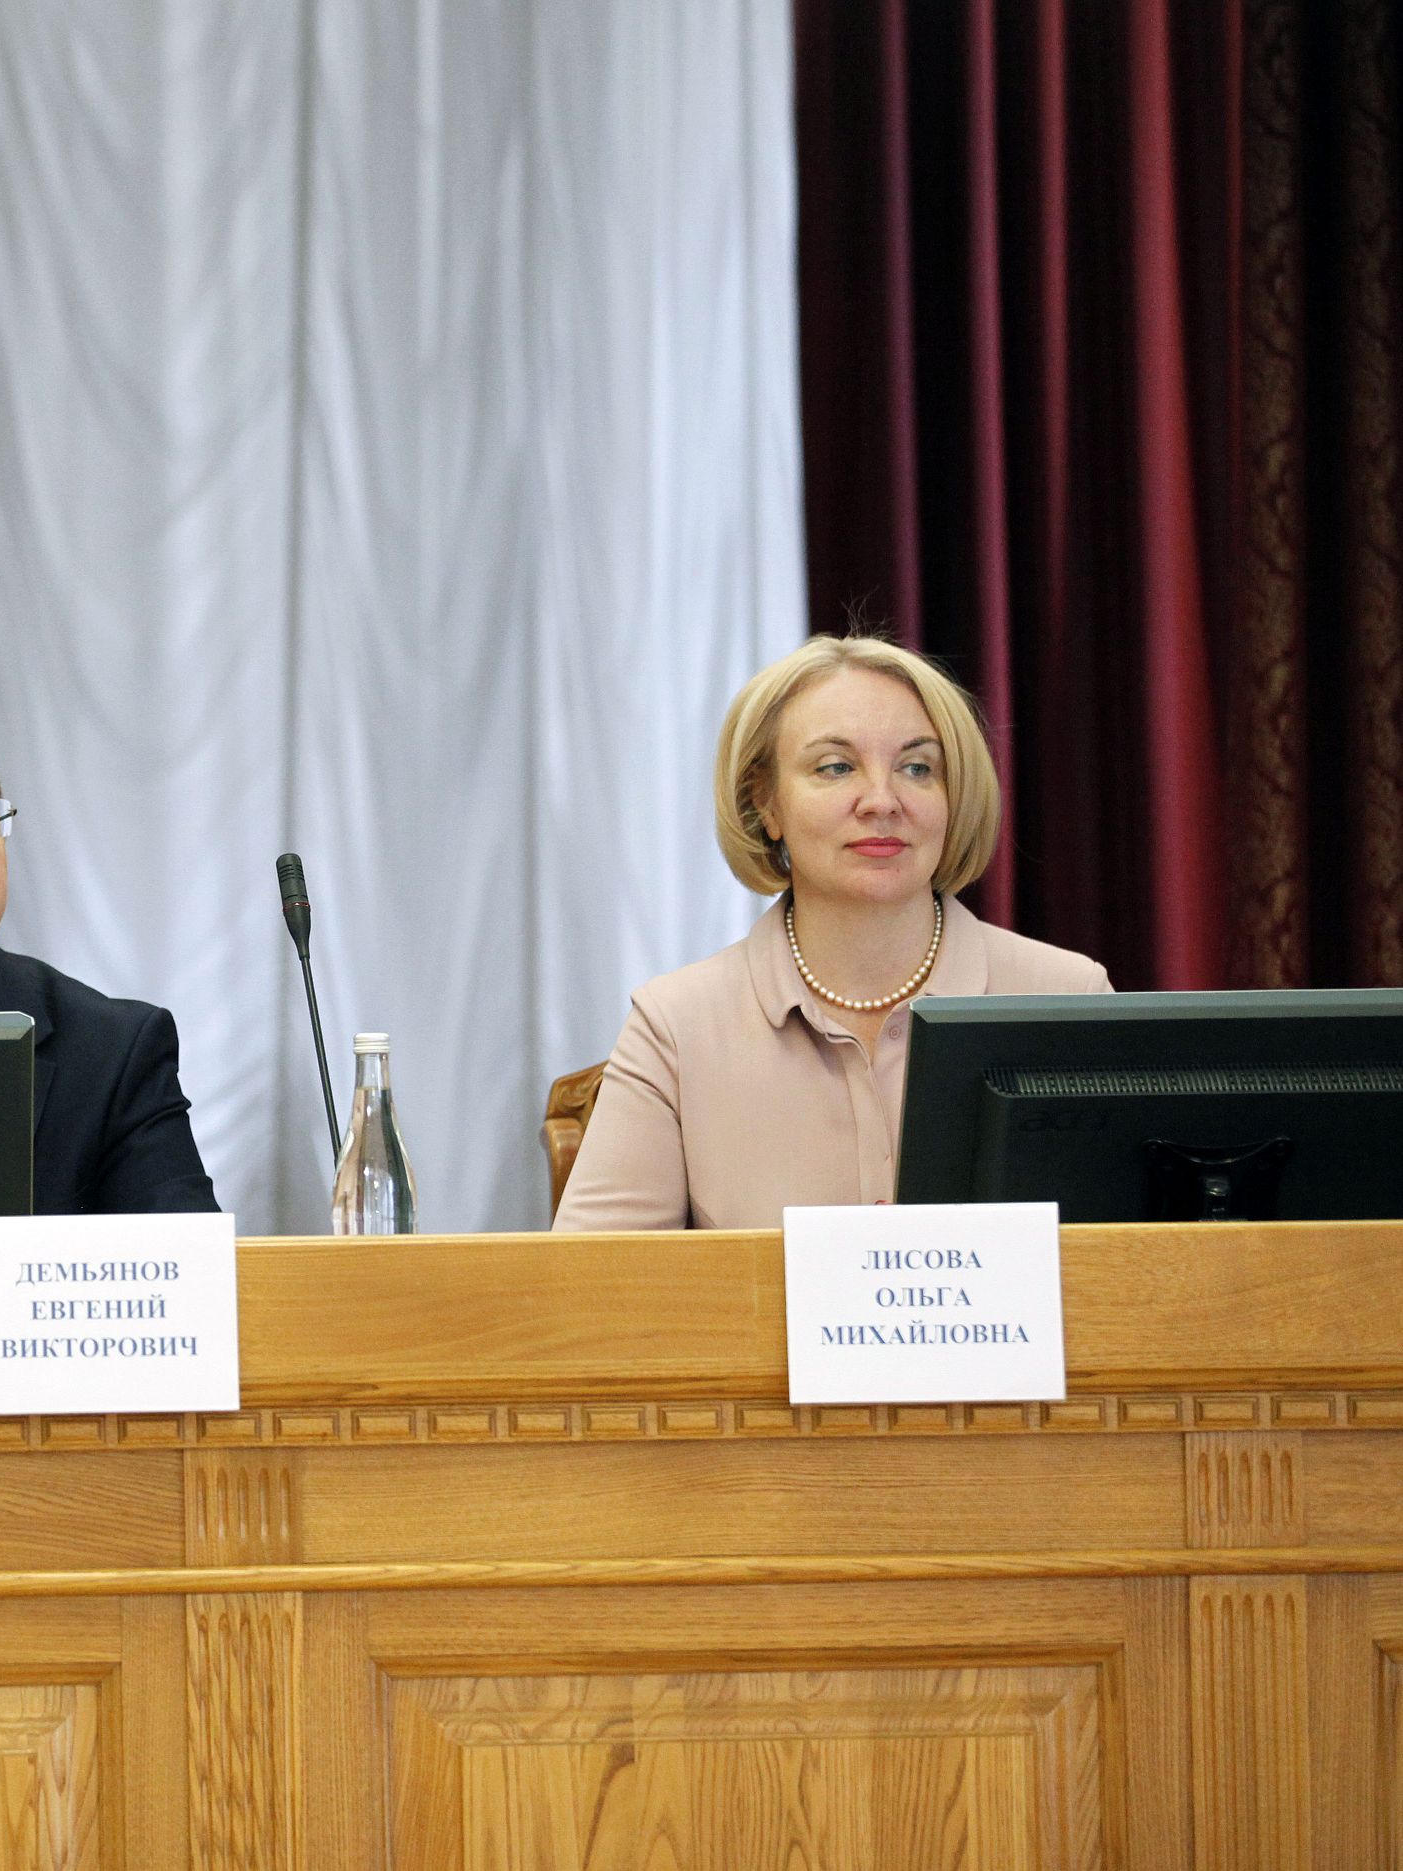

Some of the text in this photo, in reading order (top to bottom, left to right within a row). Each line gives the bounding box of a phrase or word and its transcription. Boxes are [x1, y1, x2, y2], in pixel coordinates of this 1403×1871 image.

[861, 1249, 982, 1270] ЛИСОВА
[15, 1260, 180, 1286] ДЕМЬЯНОВ
[31, 1294, 166, 1321] ЕВГЕНИЙ
[875, 1286, 972, 1307] ОЛЬГА
[821, 1320, 1030, 1346] МИХАЙЛОВНА
[1, 1336, 198, 1359] ВИКТОРОВИЧ
